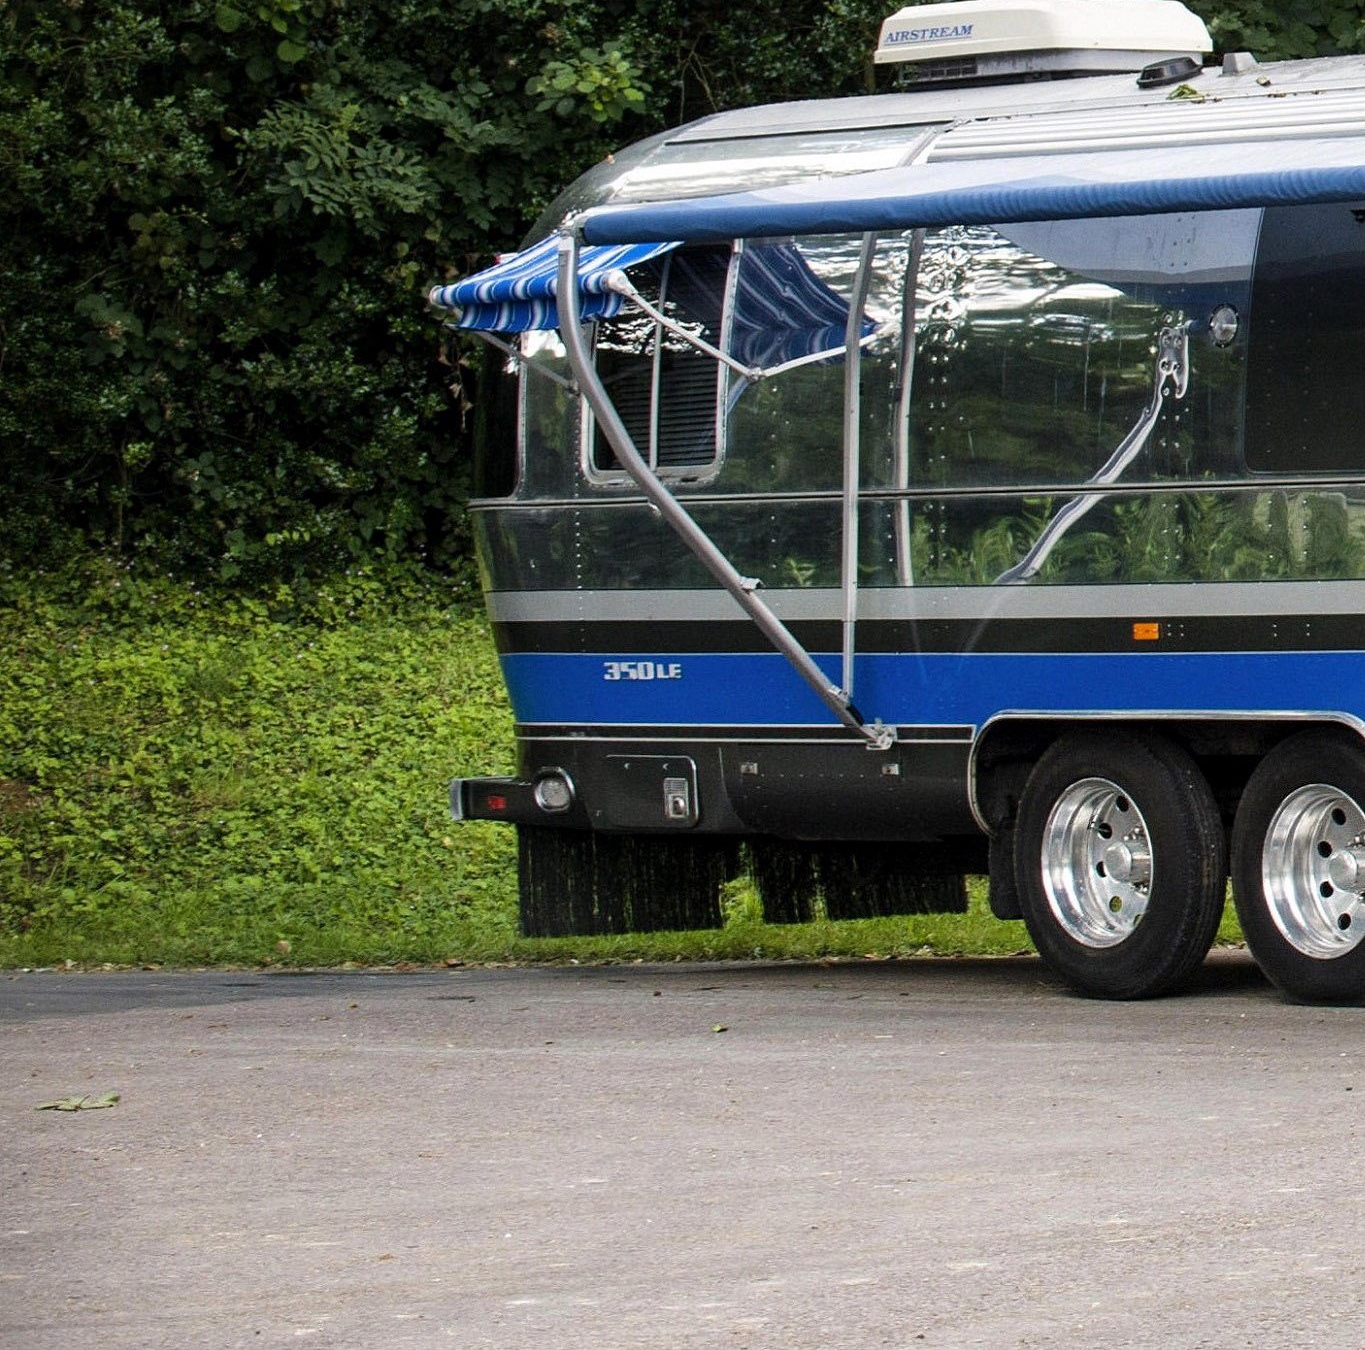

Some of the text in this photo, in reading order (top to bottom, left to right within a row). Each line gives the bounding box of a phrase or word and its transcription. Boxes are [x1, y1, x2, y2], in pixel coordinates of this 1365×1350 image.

[885, 25, 974, 43] AIRSTREAM
[603, 662, 682, 680] 350 LE
